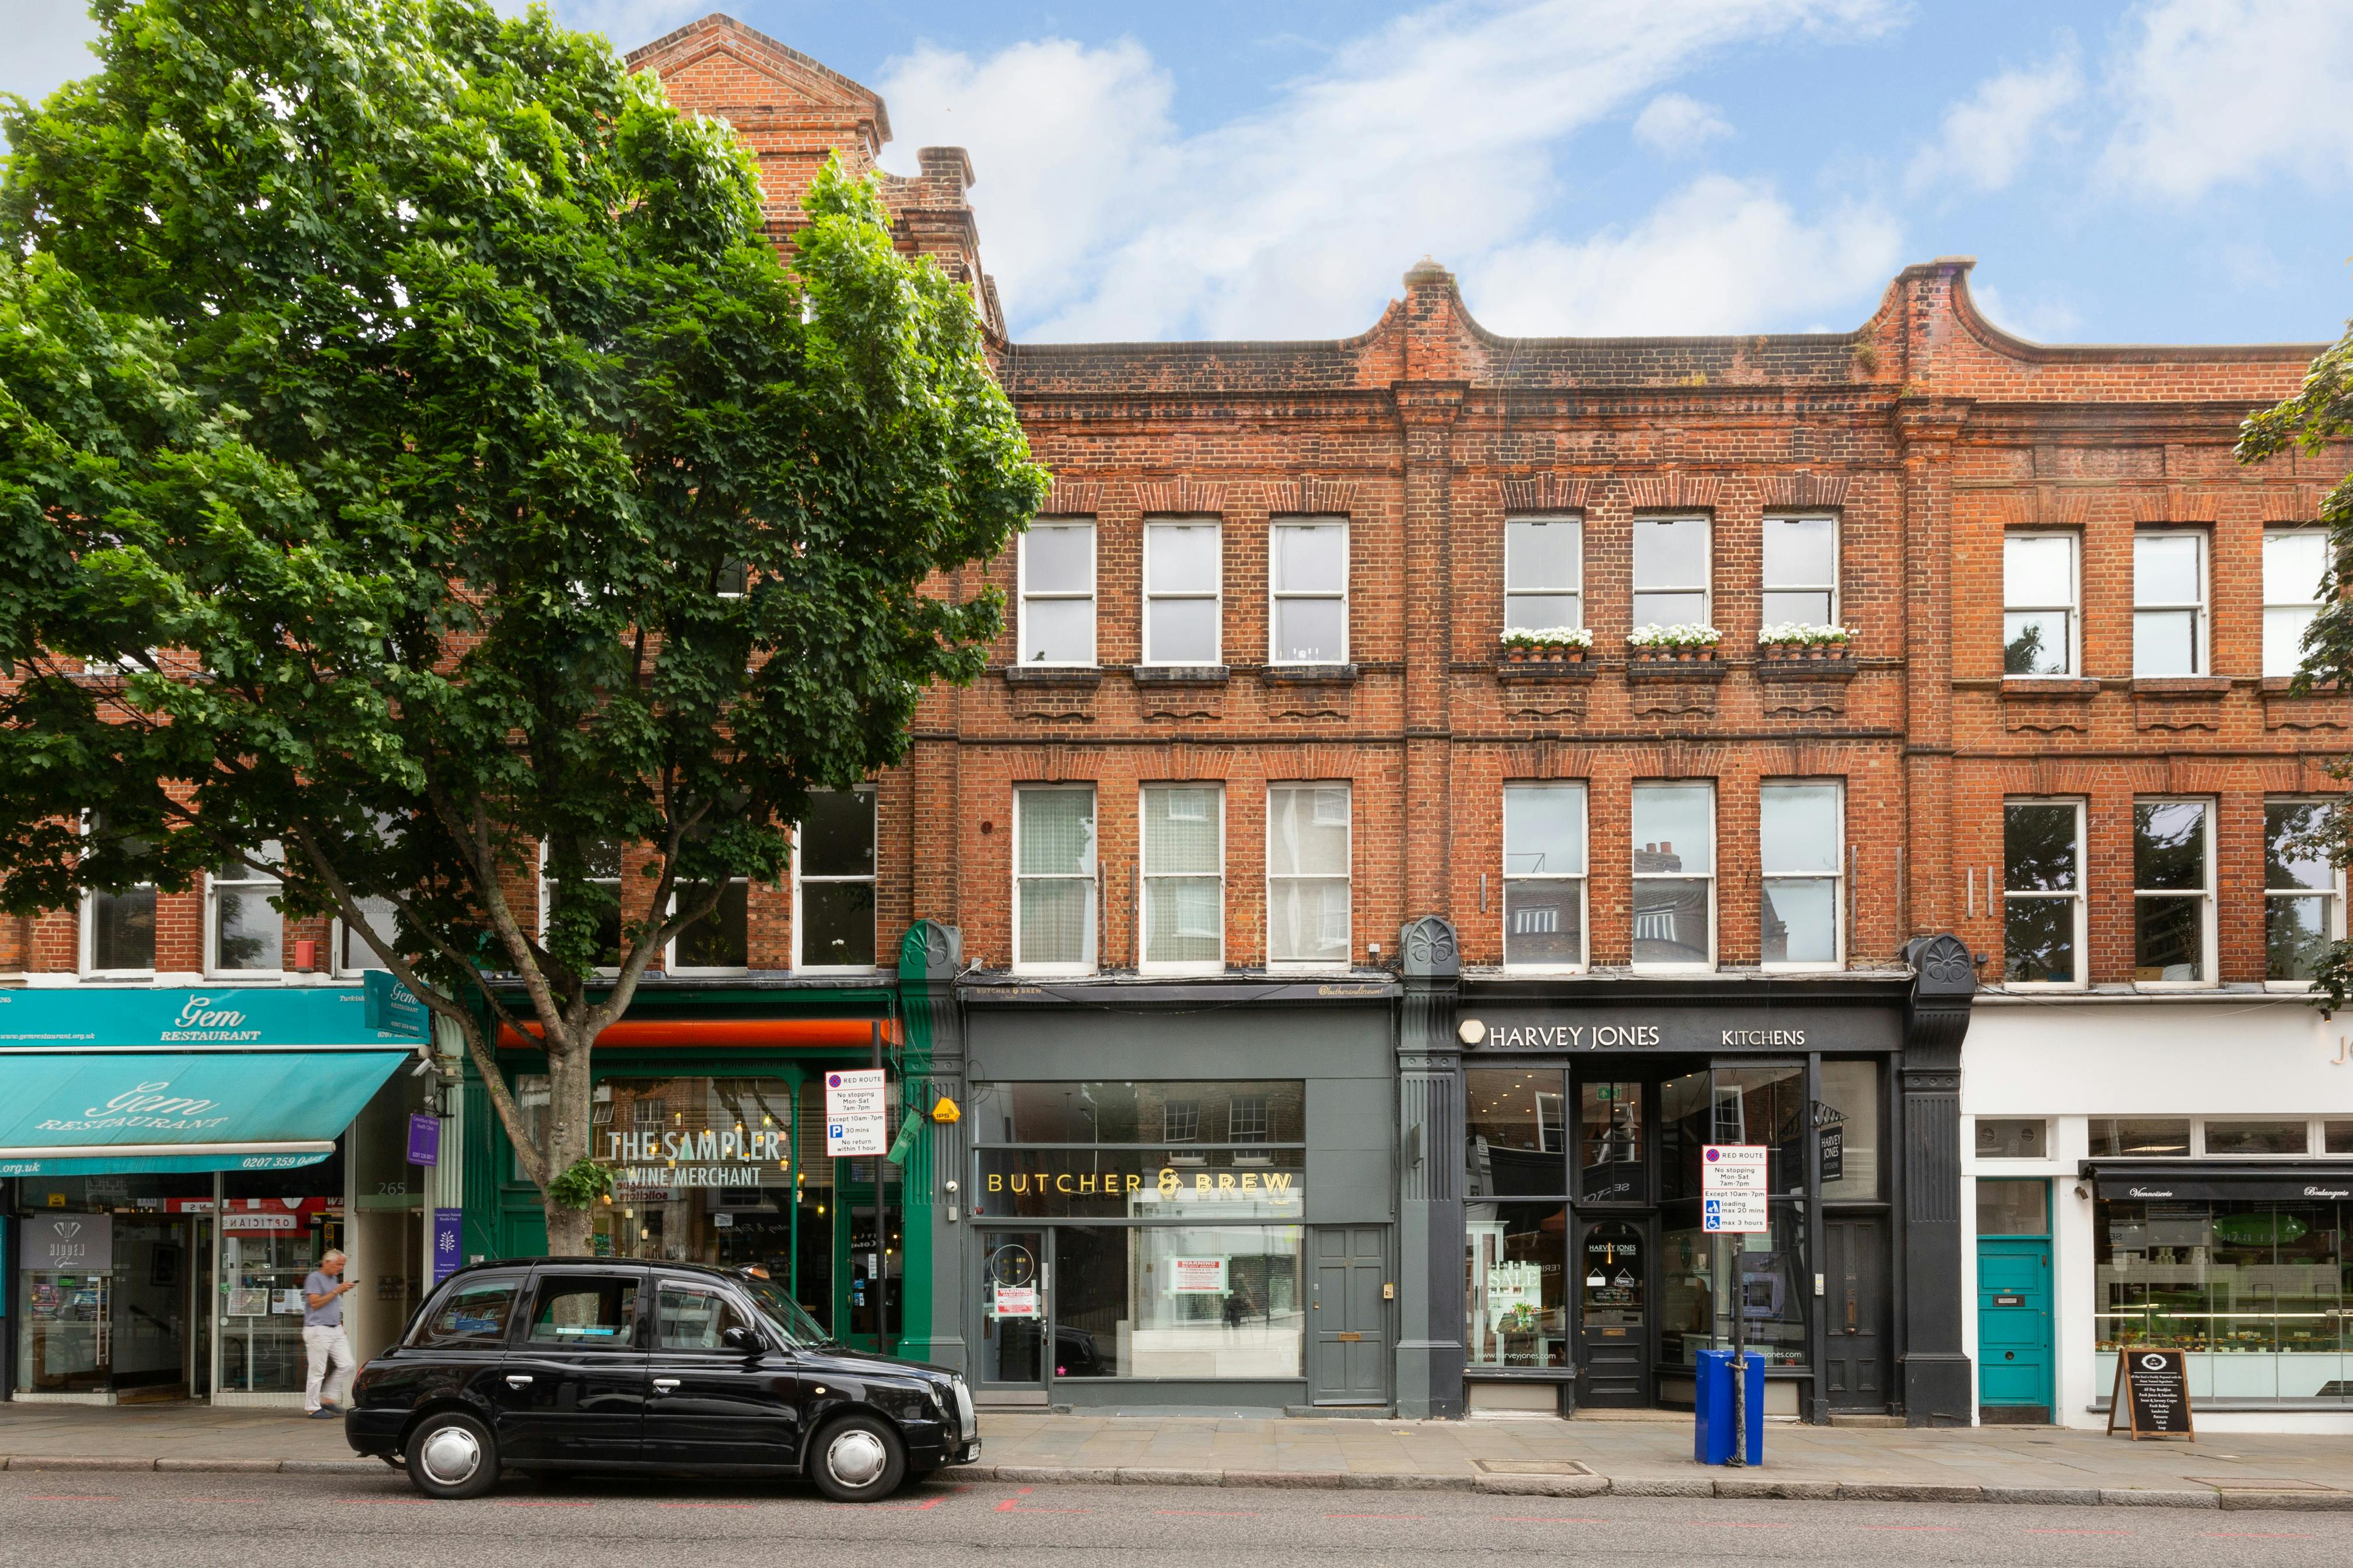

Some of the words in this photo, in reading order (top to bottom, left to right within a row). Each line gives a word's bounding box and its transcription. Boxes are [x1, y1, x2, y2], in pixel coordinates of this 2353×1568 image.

[390, 980, 418, 1005] Gem
[174, 994, 246, 1027] Gem
[391, 1002, 418, 1013] RESTAURANT
[160, 1031, 261, 1041] RESTAURANT
[1490, 1026, 1583, 1046] HARVEY
[1591, 1026, 1659, 1050] JONES
[1722, 1030, 1805, 1045] KITCHENS
[2330, 1036, 2353, 1064] J
[85, 1081, 220, 1117] Gem
[34, 1116, 229, 1130] RESTAURANT
[607, 1132, 655, 1160] THE
[664, 1131, 780, 1160] SAMPLER
[1821, 1134, 1841, 1148] HARVEY
[1823, 1146, 1839, 1160] JONES
[243, 1157, 272, 1167] 0207
[273, 1156, 295, 1166] 359
[1824, 1162, 1839, 1170] KITCHENS
[626, 1167, 668, 1185] WINE
[674, 1167, 761, 1185] MERCHANT
[379, 1182, 406, 1195] 265
[988, 1174, 1142, 1194] BUTCHER
[1158, 1168, 1183, 1199] &
[1196, 1173, 1292, 1195] BREW
[2130, 1187, 2172, 1197] Viennoiserie
[2304, 1186, 2349, 1199] Boulangerie
[50, 1244, 85, 1255] HIDDEN
[1490, 1271, 1538, 1286] SALE
[1475, 1352, 1556, 1360] www.harveyjones.com
